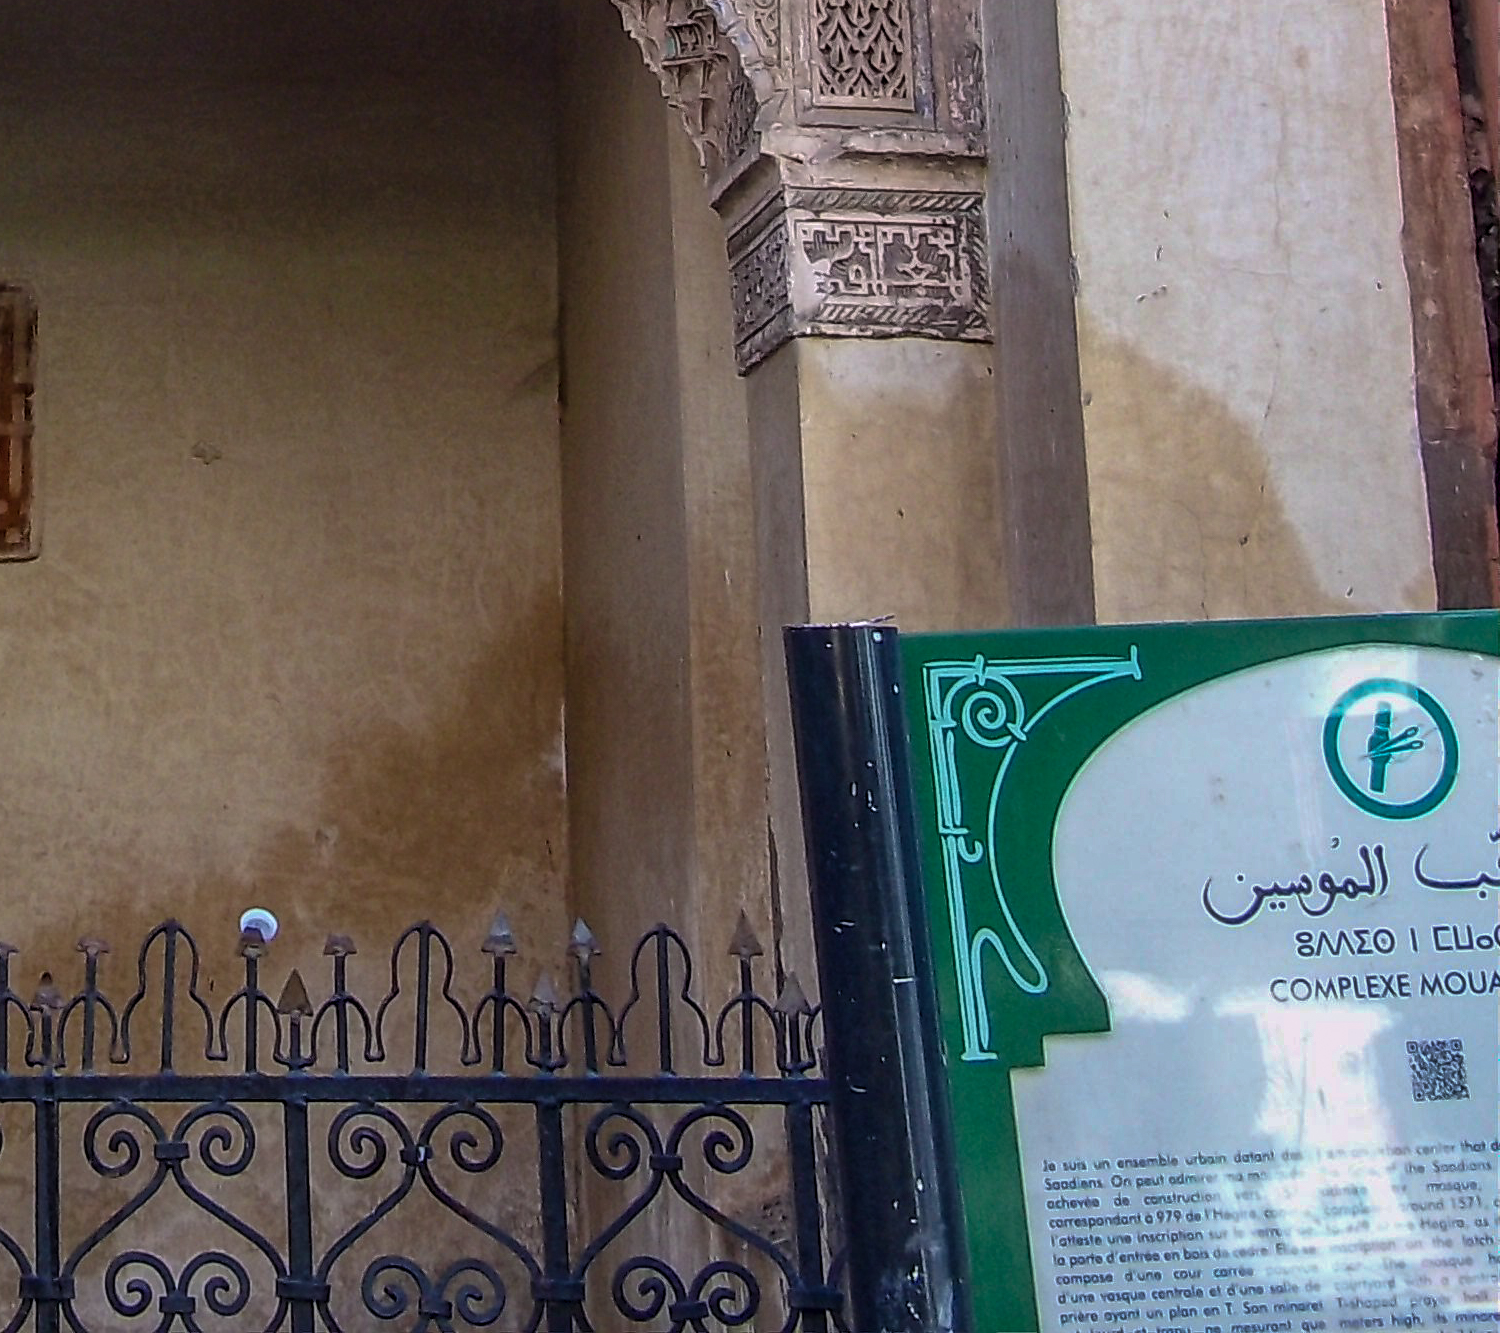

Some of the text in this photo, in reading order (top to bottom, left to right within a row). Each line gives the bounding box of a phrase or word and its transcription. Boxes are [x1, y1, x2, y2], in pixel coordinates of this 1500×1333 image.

[1269, 973, 1412, 1003] COMPLEXE
[1460, 1138, 1487, 1153] that
[1043, 1158, 1057, 1172] Je
[1063, 1160, 1087, 1172] suis
[1094, 1159, 1110, 1170] un
[1116, 1152, 1179, 1169] ensemble
[1185, 1151, 1226, 1165] urbain
[1233, 1150, 1275, 1164] datant
[1432, 1159, 1492, 1174] Saadians
[1111, 1174, 1131, 1188] On
[1135, 1173, 1164, 1189] peut
[1113, 1192, 1131, 1207] de
[1143, 1190, 1217, 1206] construction
[1048, 1213, 1141, 1229] correspondant
[1156, 1210, 1181, 1224] 979
[1106, 1234, 1132, 1245] une
[1137, 1229, 1204, 1244] inscription
[1462, 1234, 1495, 1248] latch
[1053, 1254, 1066, 1266] la
[1070, 1253, 1103, 1269] porte
[1164, 1251, 1180, 1261] en
[1183, 1247, 1210, 1261] bois
[1056, 1273, 1114, 1286] compose
[1124, 1269, 1162, 1282] d'une
[1173, 1269, 1202, 1281] cour
[1057, 1291, 1096, 1305] d'une
[1100, 1290, 1147, 1305] vasque
[1151, 1283, 1204, 1299] centrale
[1208, 1285, 1222, 1297] et
[1226, 1282, 1264, 1296] d'une
[1270, 1280, 1299, 1293] salle
[1103, 1309, 1141, 1323] ayant
[1146, 1309, 1163, 1320] un
[1169, 1305, 1198, 1321] plan
[1203, 1306, 1220, 1317] en
[1243, 1300, 1269, 1314] Son
[1273, 1300, 1323, 1313] minaret
[1231, 1319, 1292, 1332] mesurant
[1301, 1319, 1327, 1333] que
